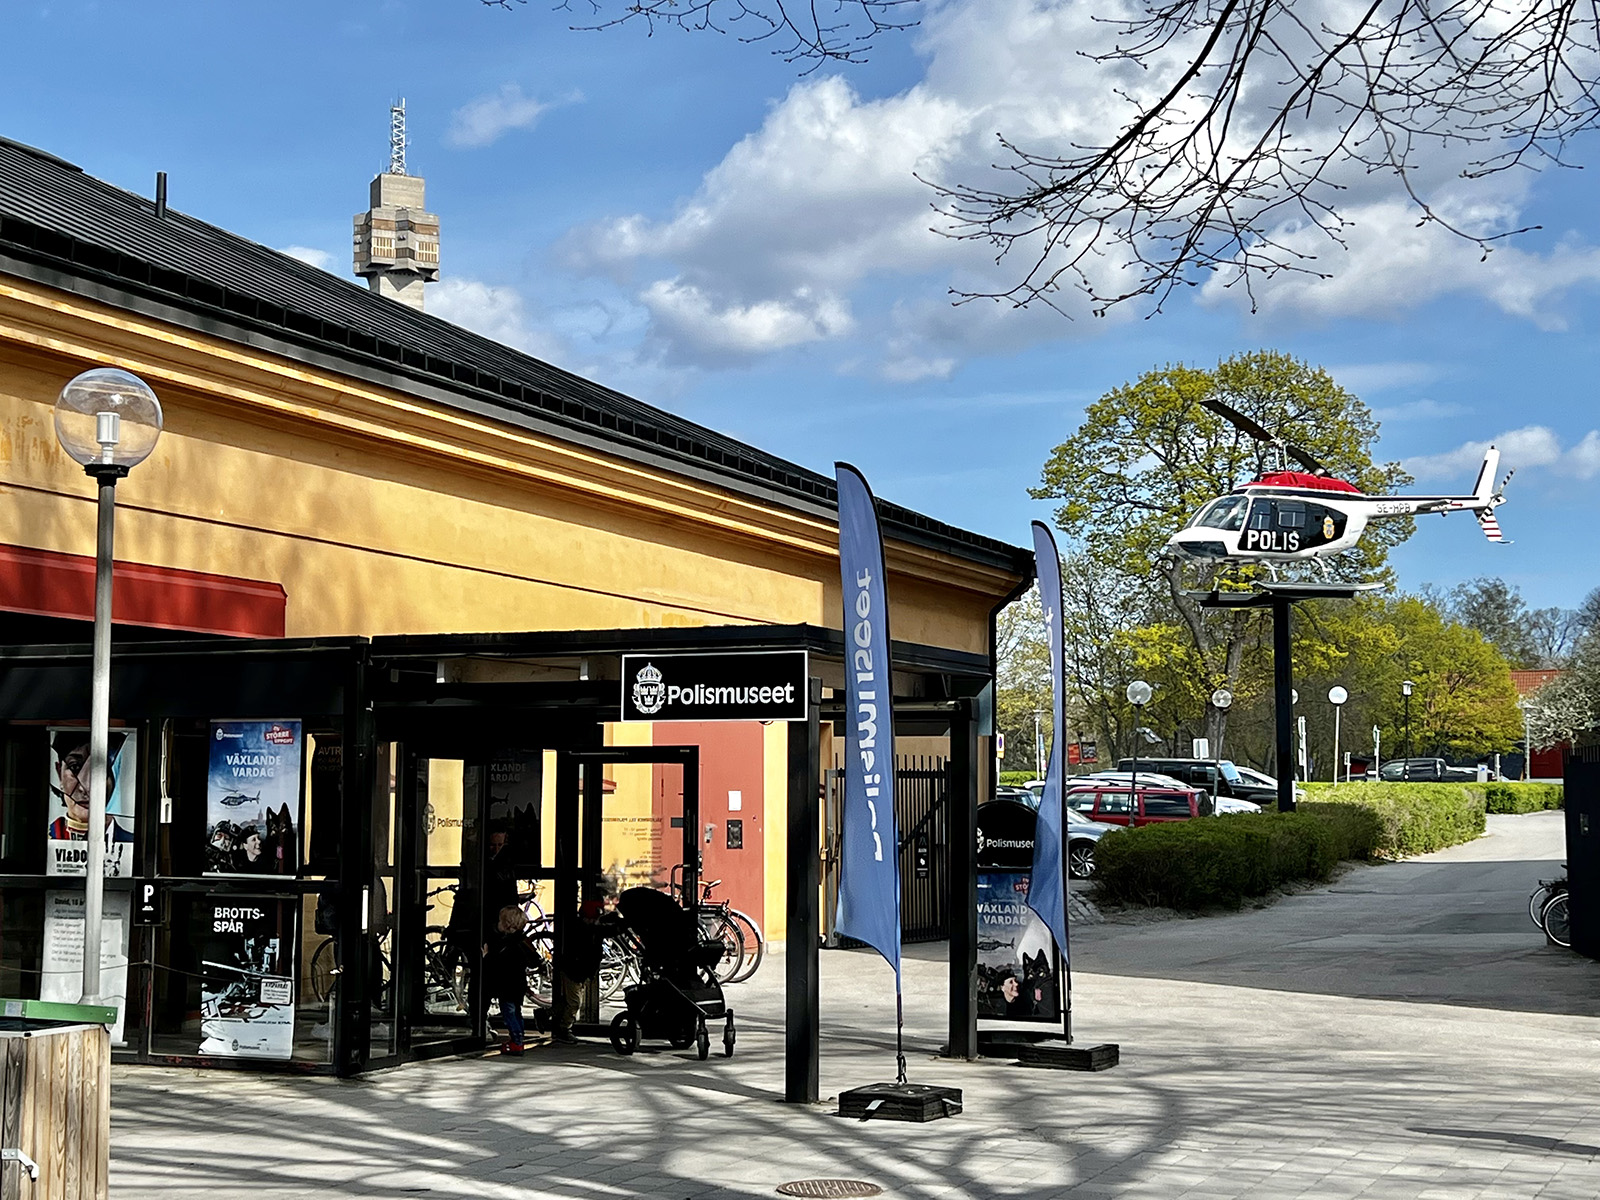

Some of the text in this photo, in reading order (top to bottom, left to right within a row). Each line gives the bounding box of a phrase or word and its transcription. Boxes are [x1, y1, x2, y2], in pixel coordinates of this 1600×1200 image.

[1376, 503, 1411, 514] SE-HPB
[1247, 530, 1300, 551] POLIS
[667, 682, 795, 705] Polismuseet
[226, 753, 282, 766] VÄXLANDE
[232, 767, 275, 778] VARDAG
[986, 838, 1035, 848] Polismuse
[143, 884, 155, 903] P
[213, 907, 265, 920] BROTTS-
[976, 902, 1028, 914] VÄXLAND
[213, 919, 244, 933] SPÅR
[983, 915, 1027, 925] VARDAG
